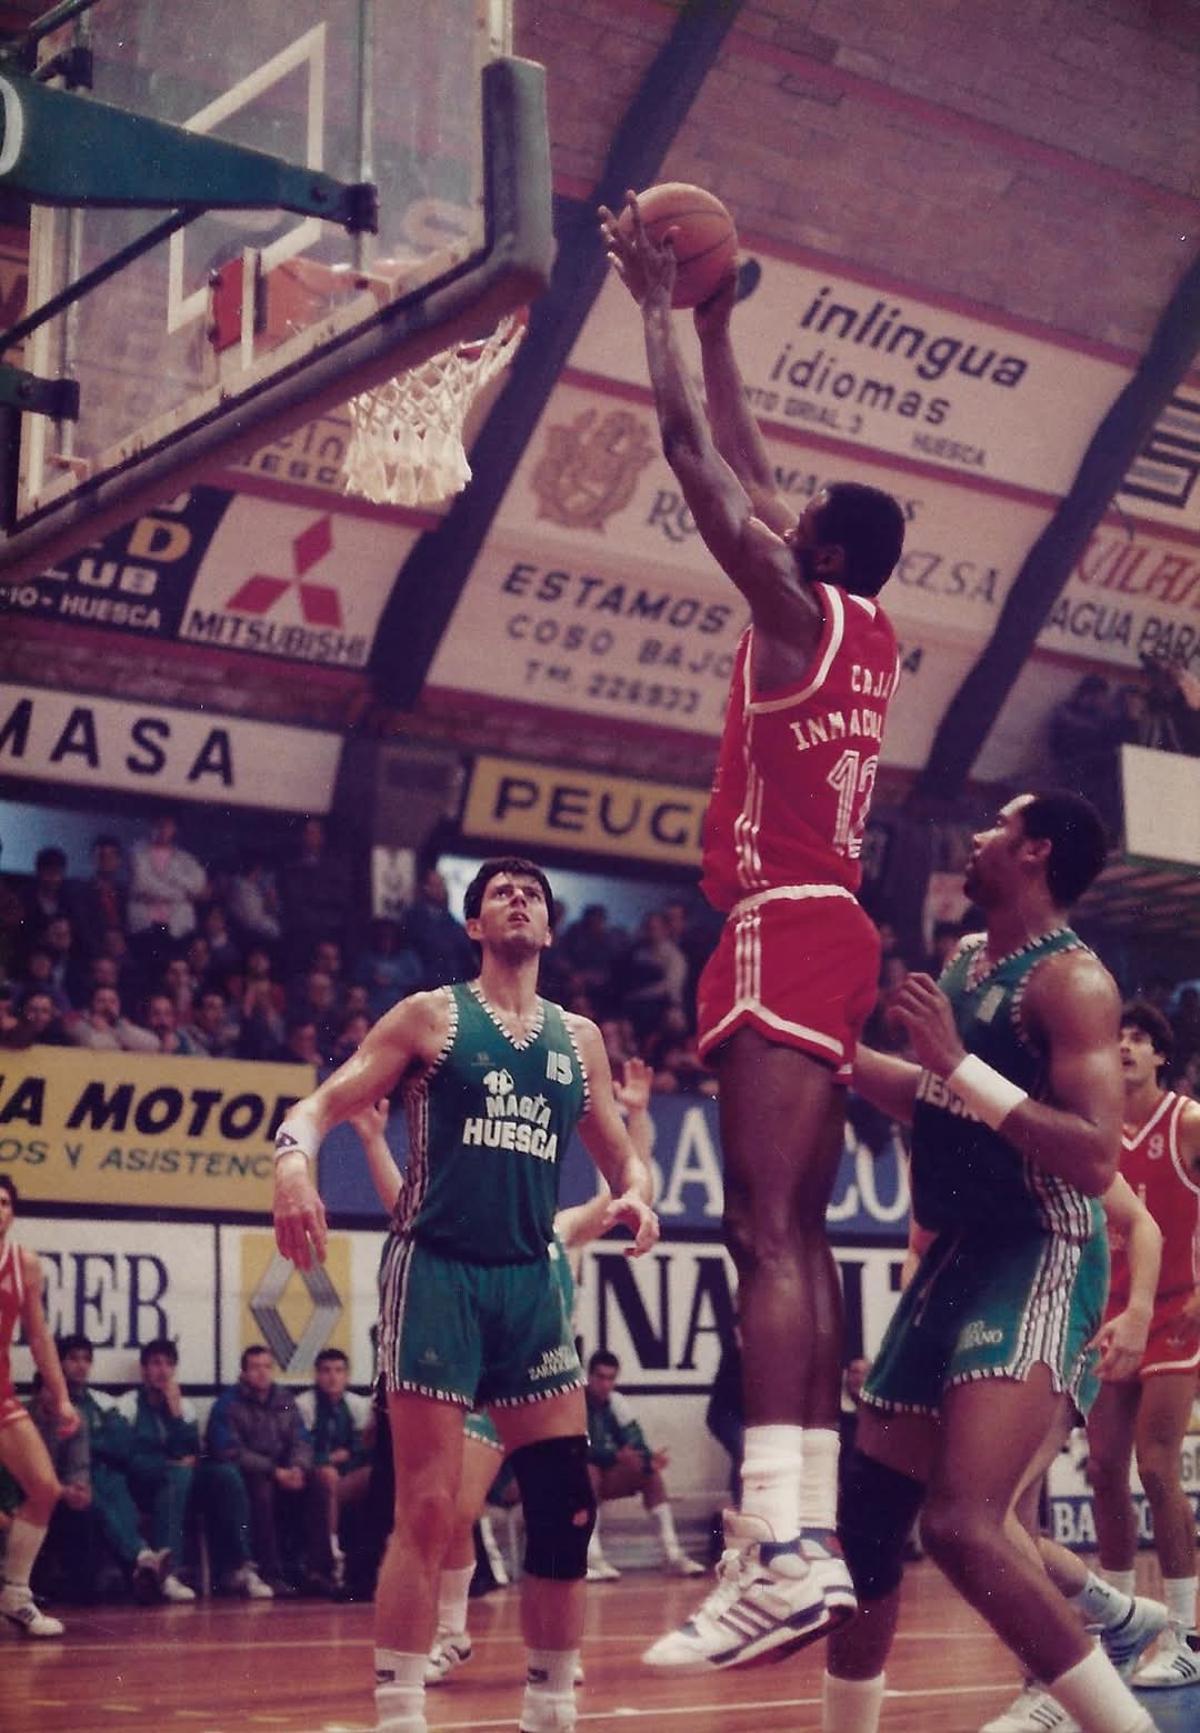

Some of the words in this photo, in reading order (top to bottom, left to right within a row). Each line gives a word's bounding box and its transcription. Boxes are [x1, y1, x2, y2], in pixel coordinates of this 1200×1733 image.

[801, 287, 1029, 388] inlingua
[770, 343, 950, 425] idiomas
[59, 593, 161, 630] HUESCA
[502, 563, 734, 634] ESTAMOS
[1050, 596, 1133, 647] AGUA
[187, 610, 367, 659] MITSUBISHI
[507, 613, 615, 656] COSO
[494, 776, 706, 847] PEUG
[485, 1094, 552, 1130] MAGIA
[64, 1142, 82, 1169] Y
[462, 1117, 558, 1163] HUESCA
